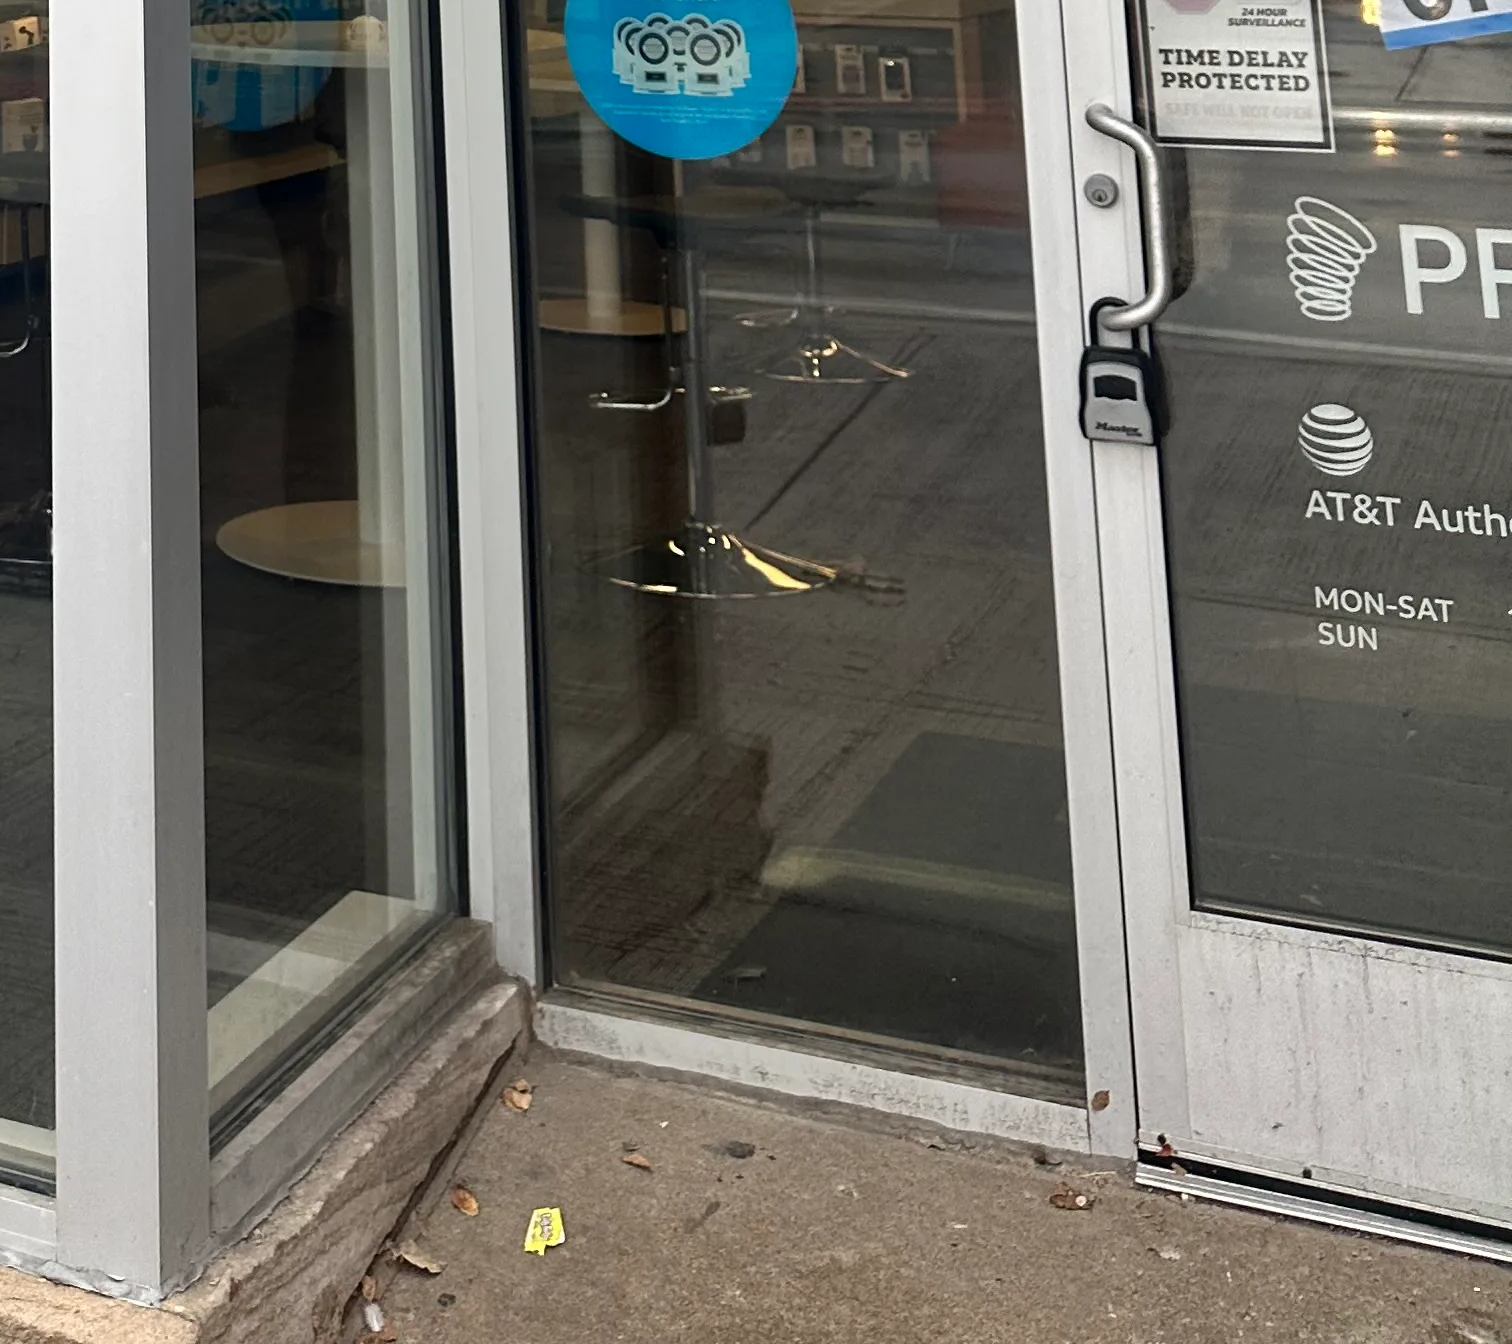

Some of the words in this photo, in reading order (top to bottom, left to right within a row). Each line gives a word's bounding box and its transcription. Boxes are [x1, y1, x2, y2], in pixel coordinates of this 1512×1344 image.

[1228, 17, 1307, 28] SURVEILLANCE
[1241, 8, 1255, 17] 24
[1256, 8, 1288, 17] HOUR
[1159, 48, 1222, 66] TIME
[1227, 50, 1308, 68] DELAY
[1161, 72, 1310, 92] PROTECTED
[1305, 489, 1401, 527] AT&T
[1414, 499, 1512, 538] Auth
[1314, 585, 1454, 623] MON-SAT
[1318, 622, 1378, 651] SUN
